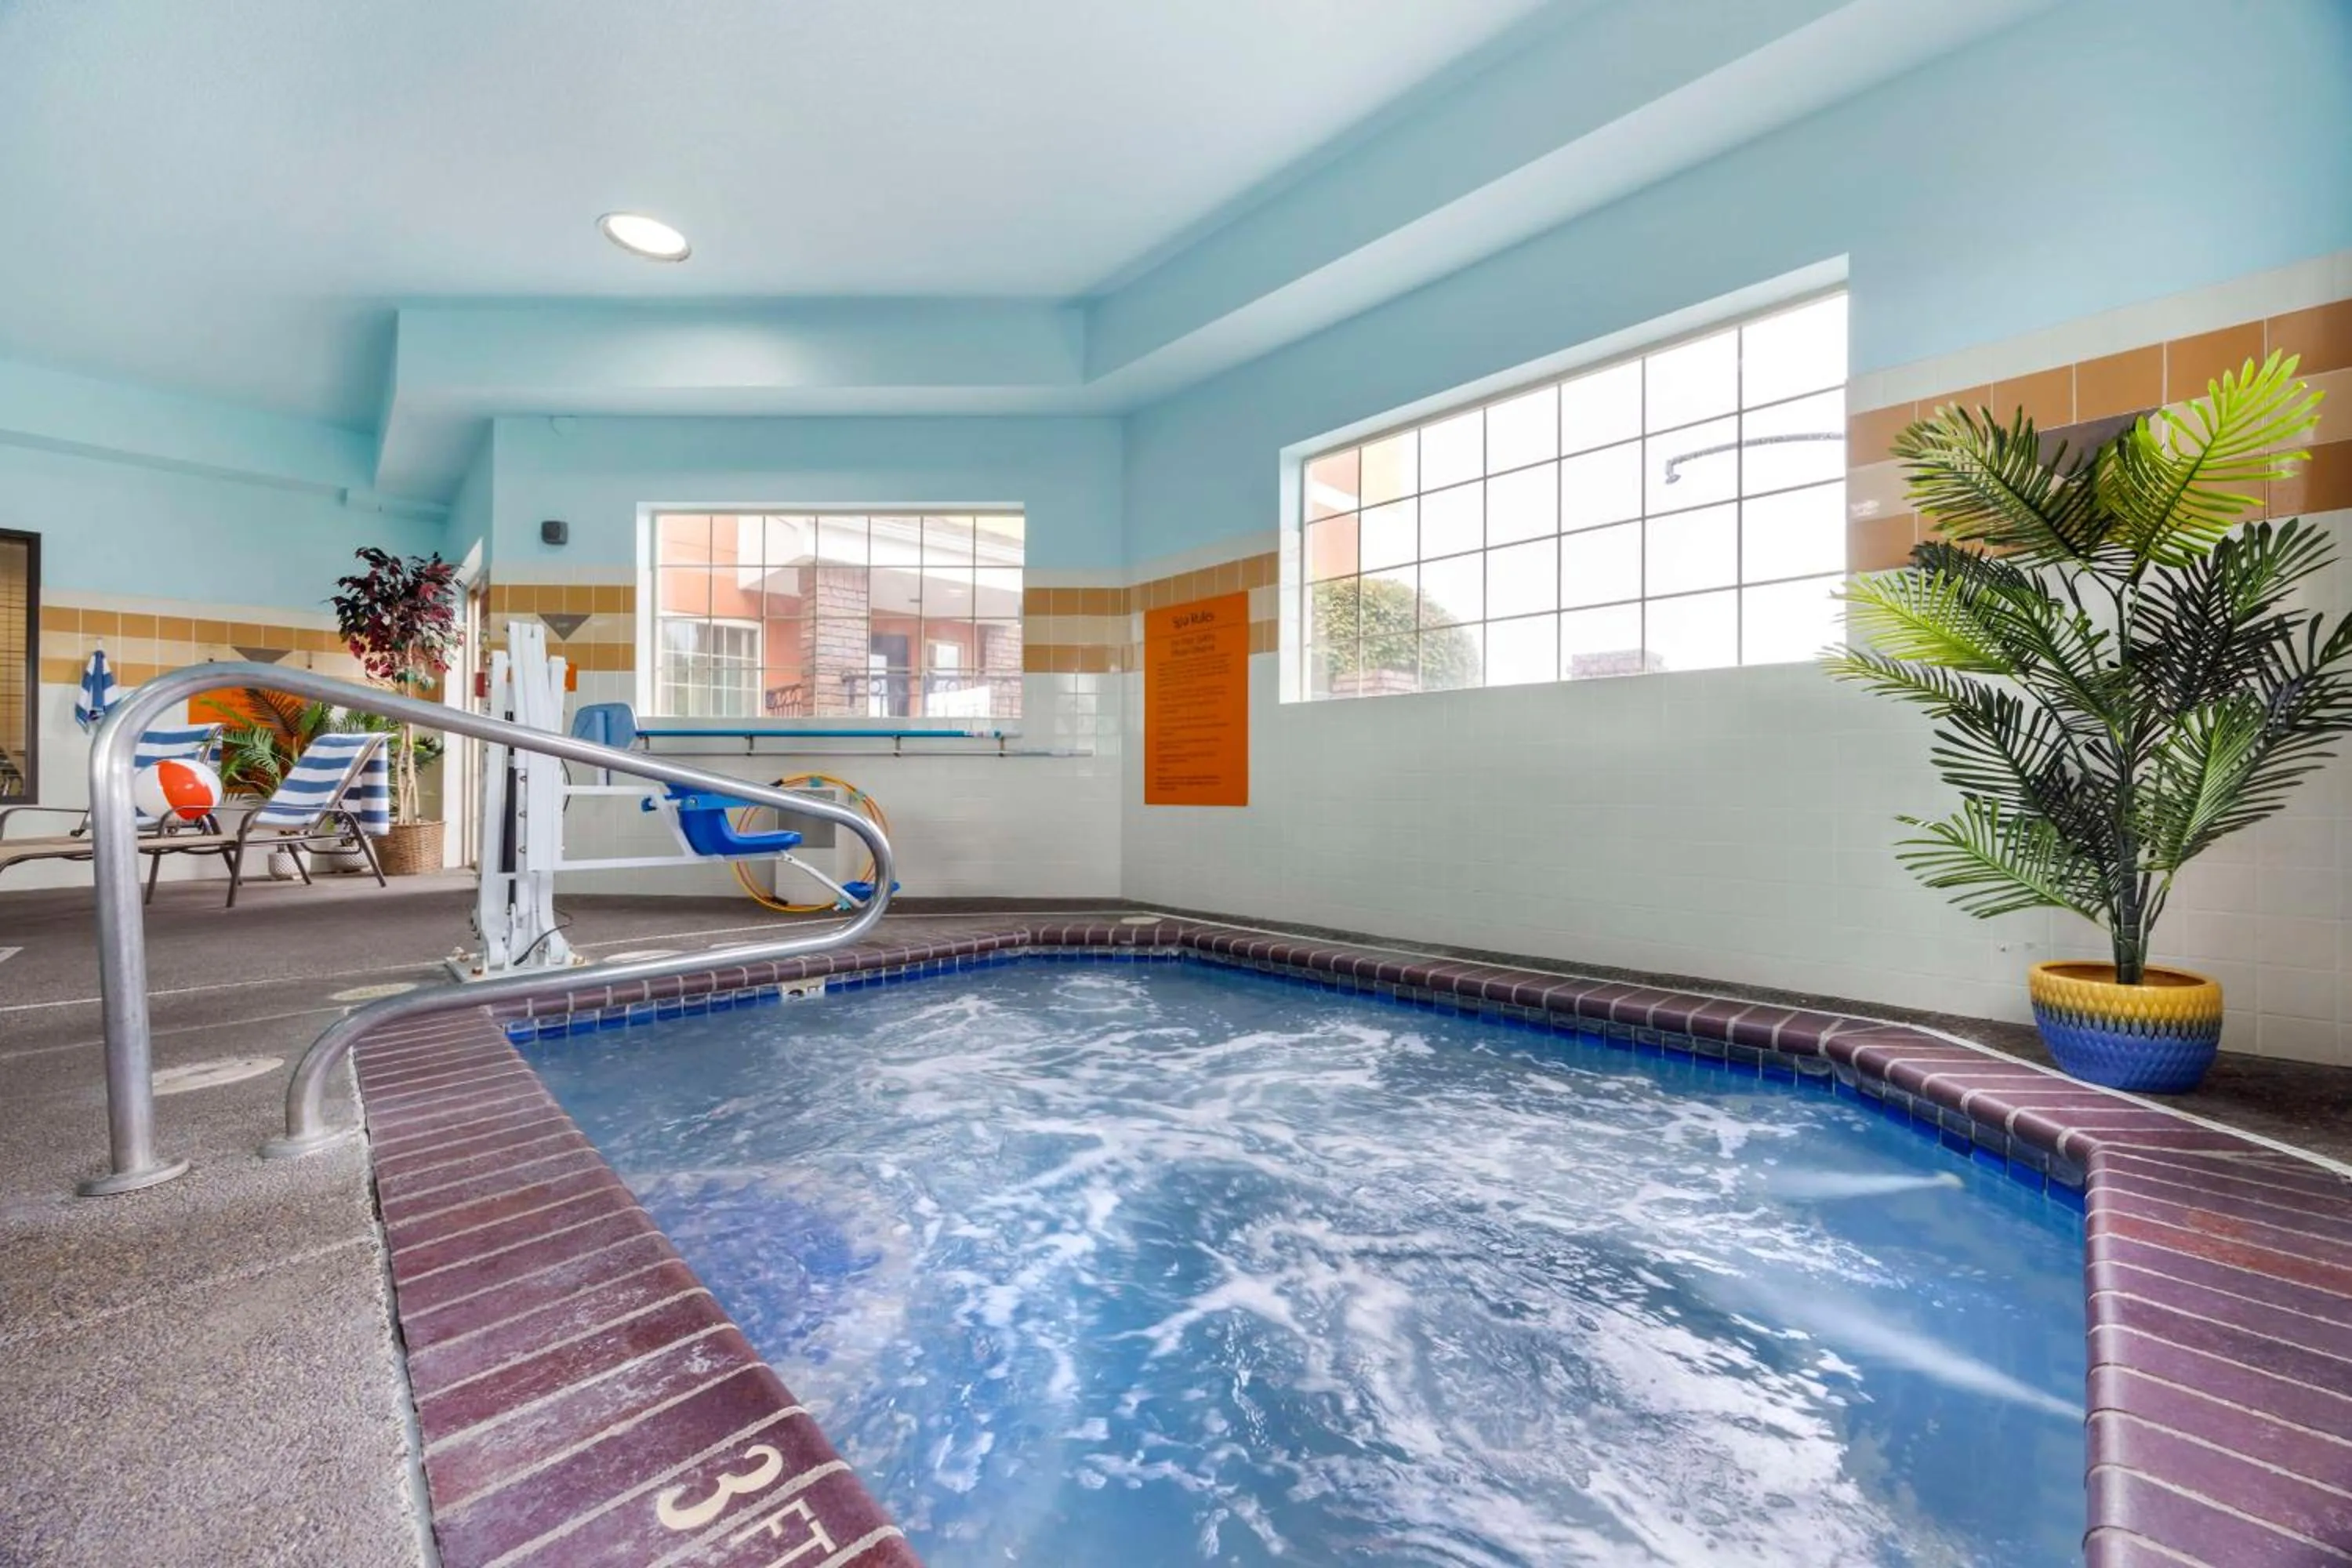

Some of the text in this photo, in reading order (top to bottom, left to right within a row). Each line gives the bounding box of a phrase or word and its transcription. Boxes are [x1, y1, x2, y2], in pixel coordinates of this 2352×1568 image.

[1172, 610, 1215, 630] Spa Rules
[656, 1444, 837, 1568] 3 FT
